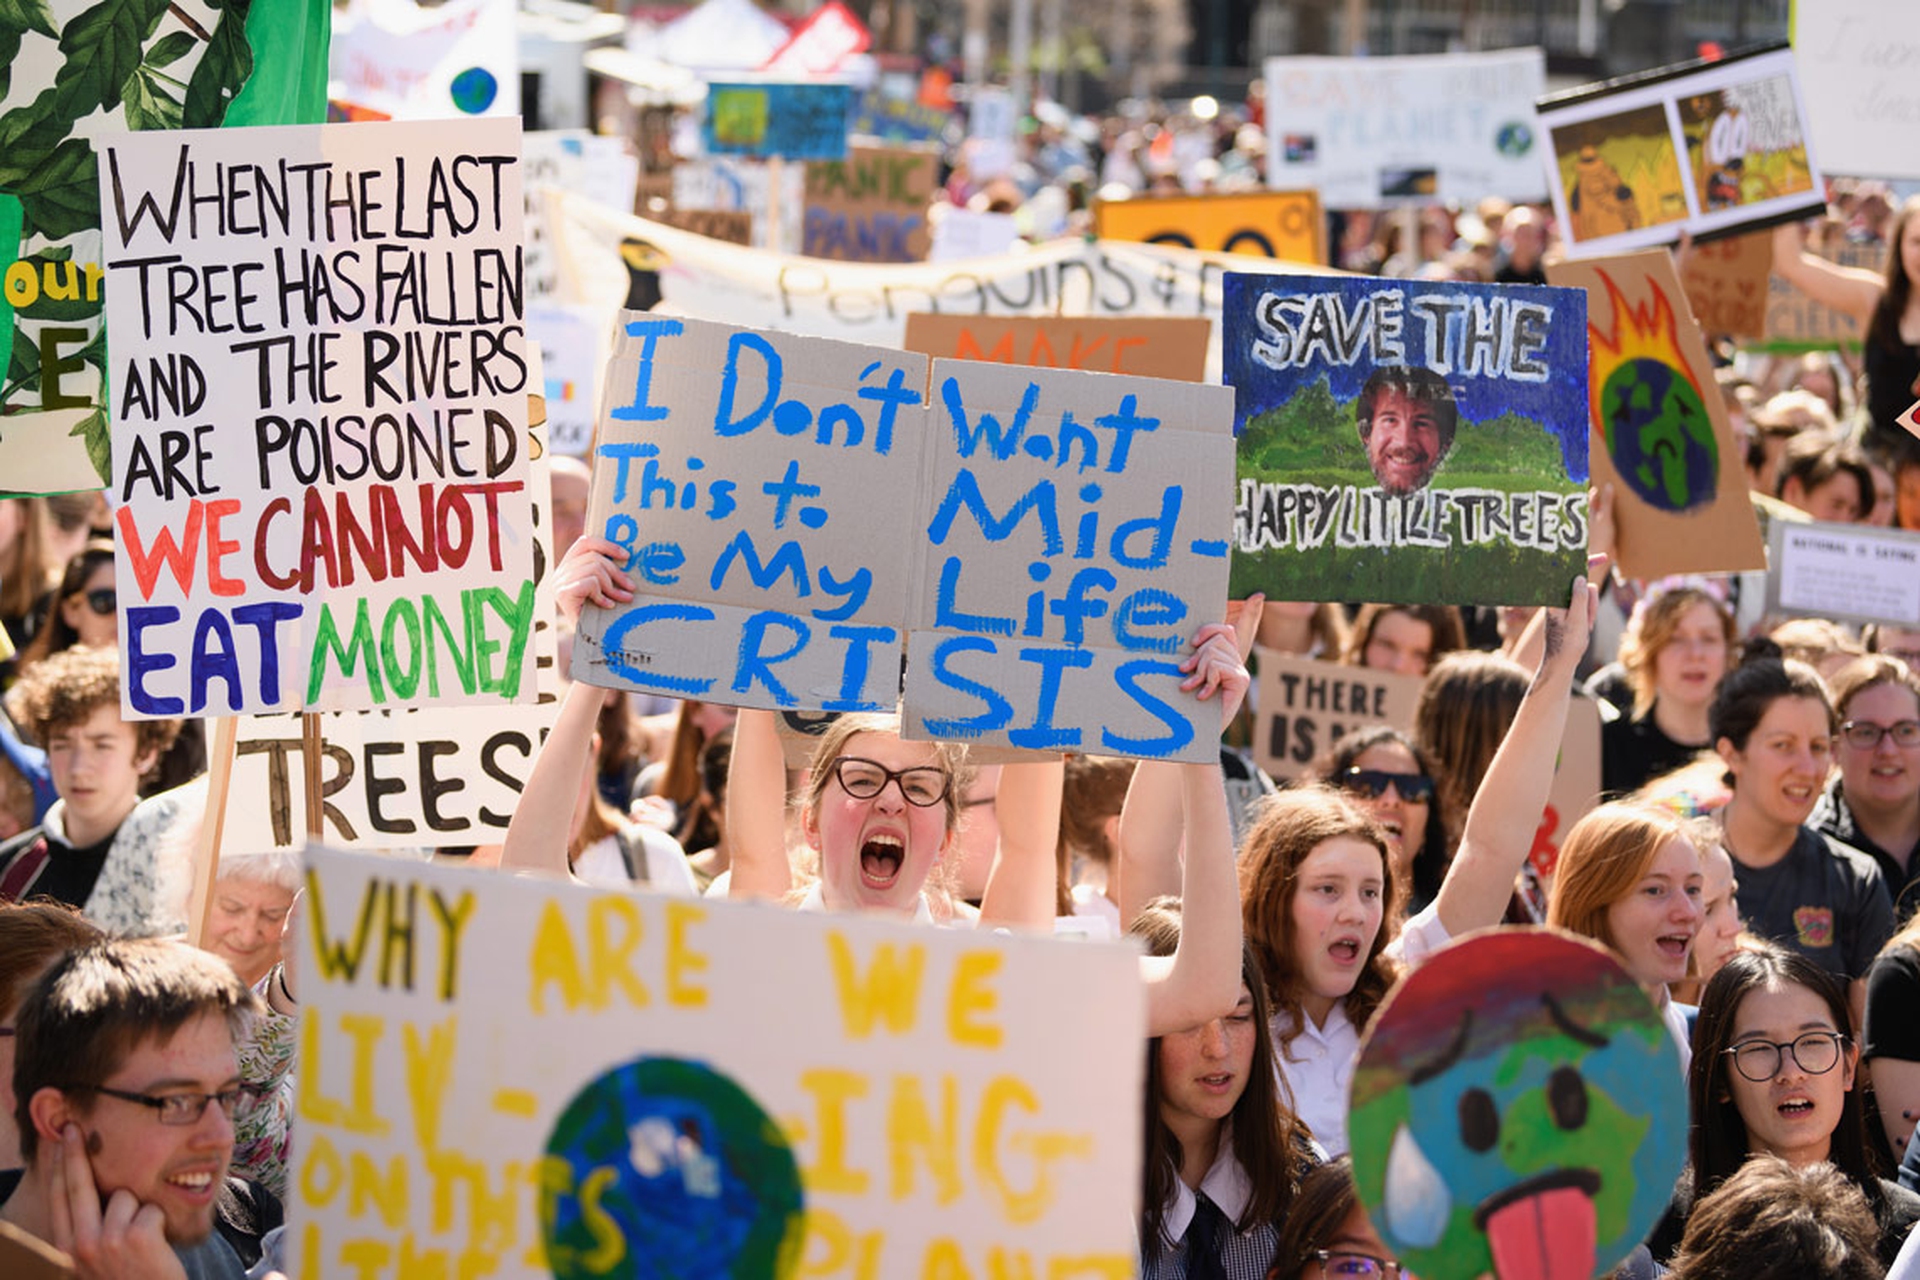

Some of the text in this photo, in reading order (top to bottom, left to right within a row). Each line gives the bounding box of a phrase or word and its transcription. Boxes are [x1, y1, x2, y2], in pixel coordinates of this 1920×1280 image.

[108, 144, 517, 248] WHEN THE LAST
[805, 206, 922, 262] PANIC
[108, 244, 524, 338] TREE HAS FALLEN
[1252, 289, 1552, 382] SAVE THE
[121, 326, 528, 421] AND THE RIVERS
[610, 319, 683, 420] I
[941, 376, 1160, 472] Want
[122, 407, 518, 502] ARE POISONED
[595, 442, 737, 520] This
[116, 481, 524, 602] WE CANNOT
[927, 468, 1228, 571] Mid-
[1236, 479, 1587, 552] HAPPY LITTLE TREES
[605, 513, 873, 622] Be My
[934, 557, 1188, 653] Life
[126, 602, 304, 715] EAT
[306, 580, 535, 704] MONEY
[1281, 672, 1387, 718] THERE
[1269, 714, 1317, 766] IS
[304, 864, 1007, 1048] WHY ARE WE
[300, 1133, 628, 1275] ON THIS
